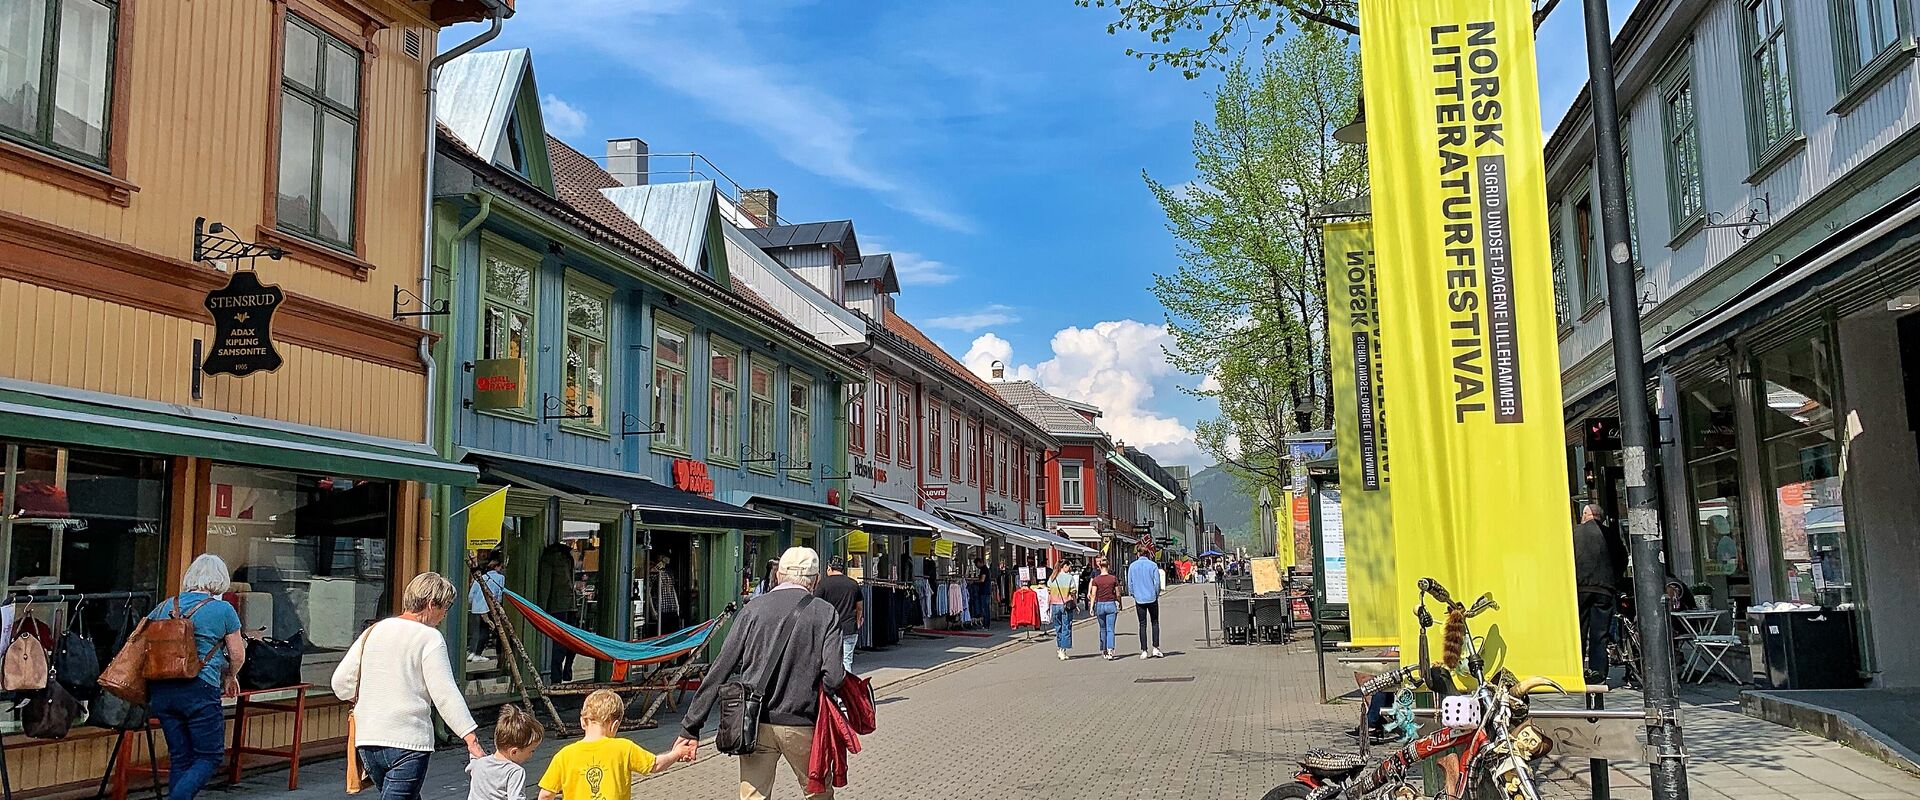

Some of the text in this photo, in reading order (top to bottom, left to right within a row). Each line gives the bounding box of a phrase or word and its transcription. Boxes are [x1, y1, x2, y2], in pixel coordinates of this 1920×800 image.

[1466, 21, 1505, 149] NORSK
[1431, 24, 1486, 424] LITTERATURFESTIVAL
[1483, 163, 1515, 416] SIGRID UNDSET-DAGENE LILLEHAMMER
[210, 293, 275, 309] STENSRUD
[230, 328, 255, 336] ADAX
[225, 338, 259, 346] KIPLING
[217, 347, 267, 356] SAMSONITE
